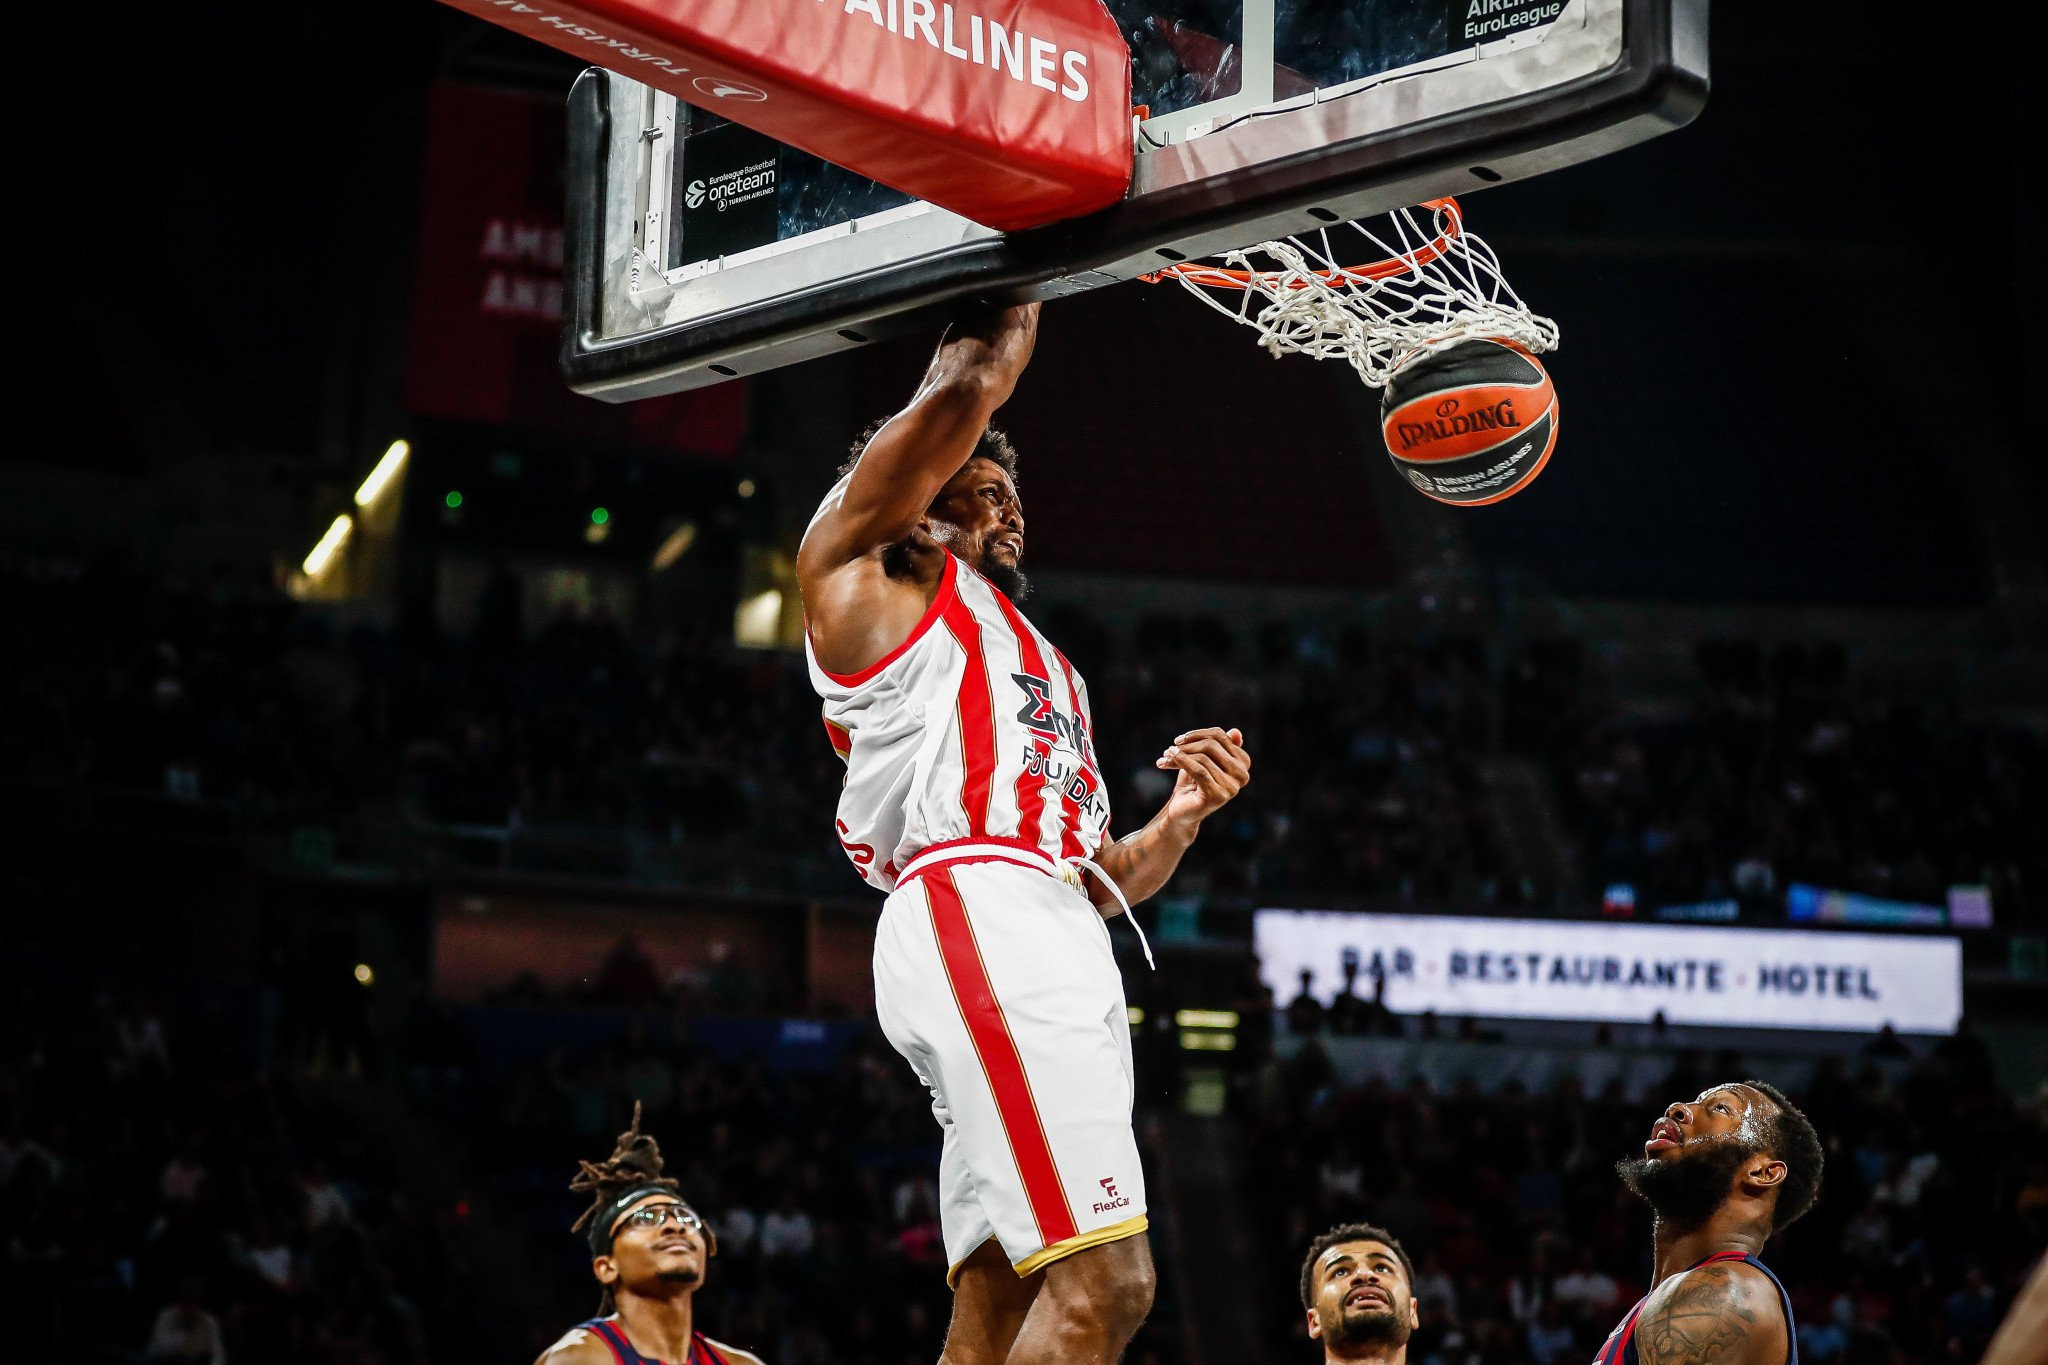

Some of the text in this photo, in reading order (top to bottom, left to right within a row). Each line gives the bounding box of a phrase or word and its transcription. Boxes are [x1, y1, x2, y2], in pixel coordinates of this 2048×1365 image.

[1464, 2, 1560, 39] EuroLeague
[538, 15, 690, 75] TURKISH
[708, 169, 775, 201] oneteam
[709, 158, 776, 185] Euroleague Basketball
[728, 187, 775, 206] TURKISH AIRLINES
[1397, 398, 1520, 450] SPALDING
[1339, 944, 1880, 1002] BAR RESTAURANTE HOTEL
